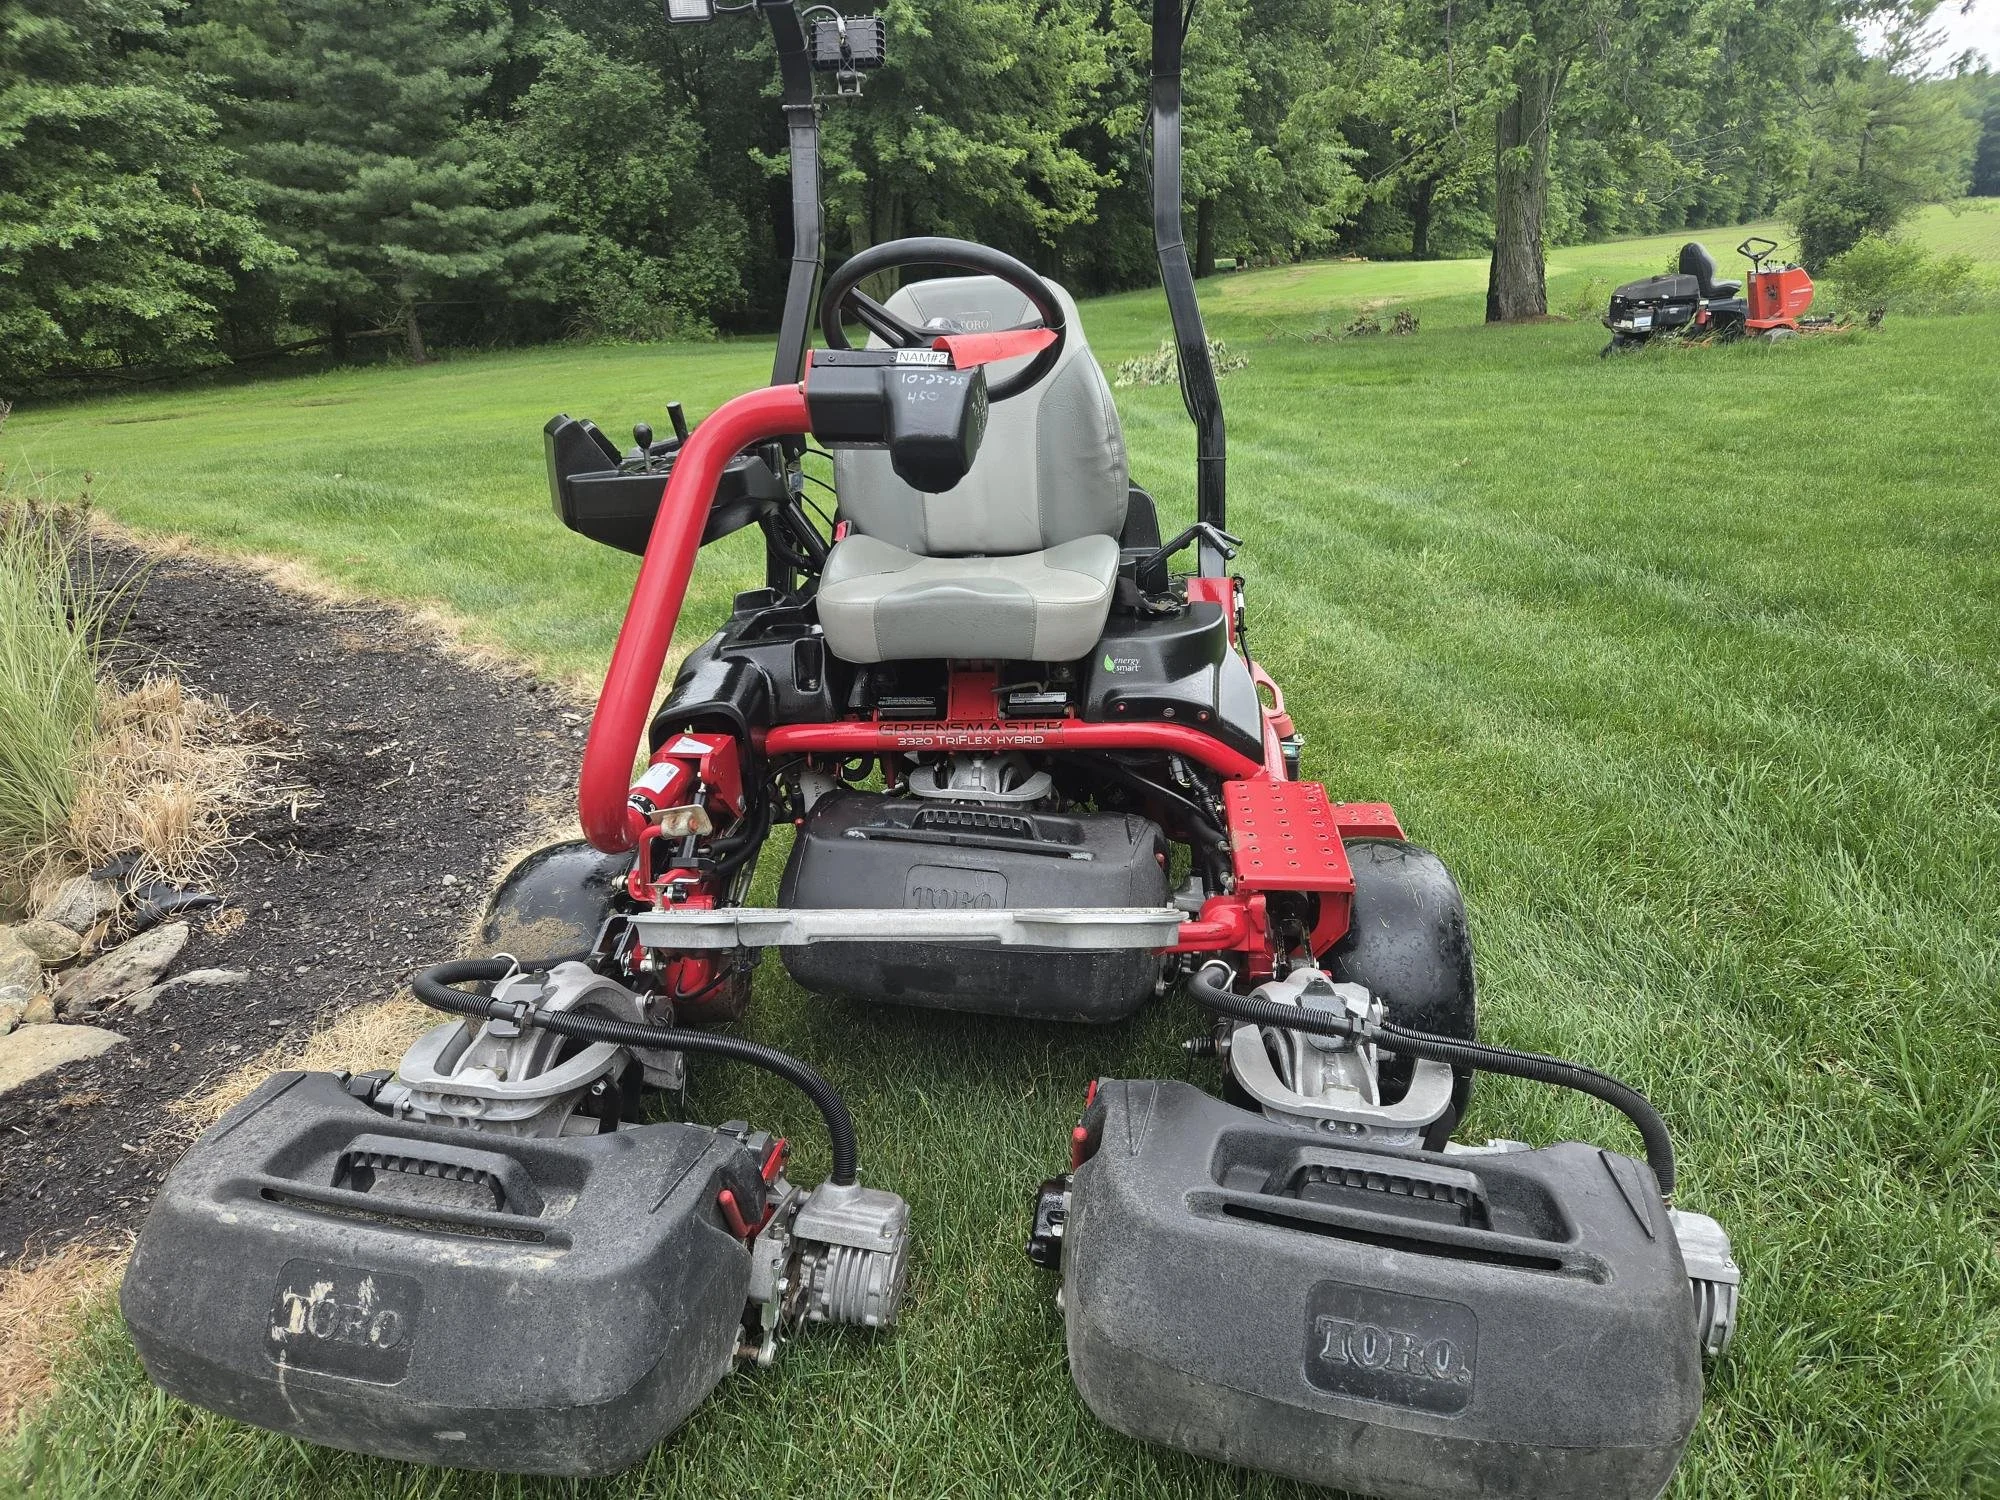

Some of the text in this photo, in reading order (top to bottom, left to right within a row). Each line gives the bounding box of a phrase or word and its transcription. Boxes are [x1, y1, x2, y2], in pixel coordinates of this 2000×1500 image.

[899, 352, 946, 364] NAM#2
[1114, 658, 1140, 666] energy
[878, 721, 1062, 736] GREENSMASTER
[897, 737, 933, 746] 3320
[997, 735, 1044, 745] HYBRID
[281, 1287, 406, 1350] TORO
[1315, 1314, 1465, 1380] TORO
